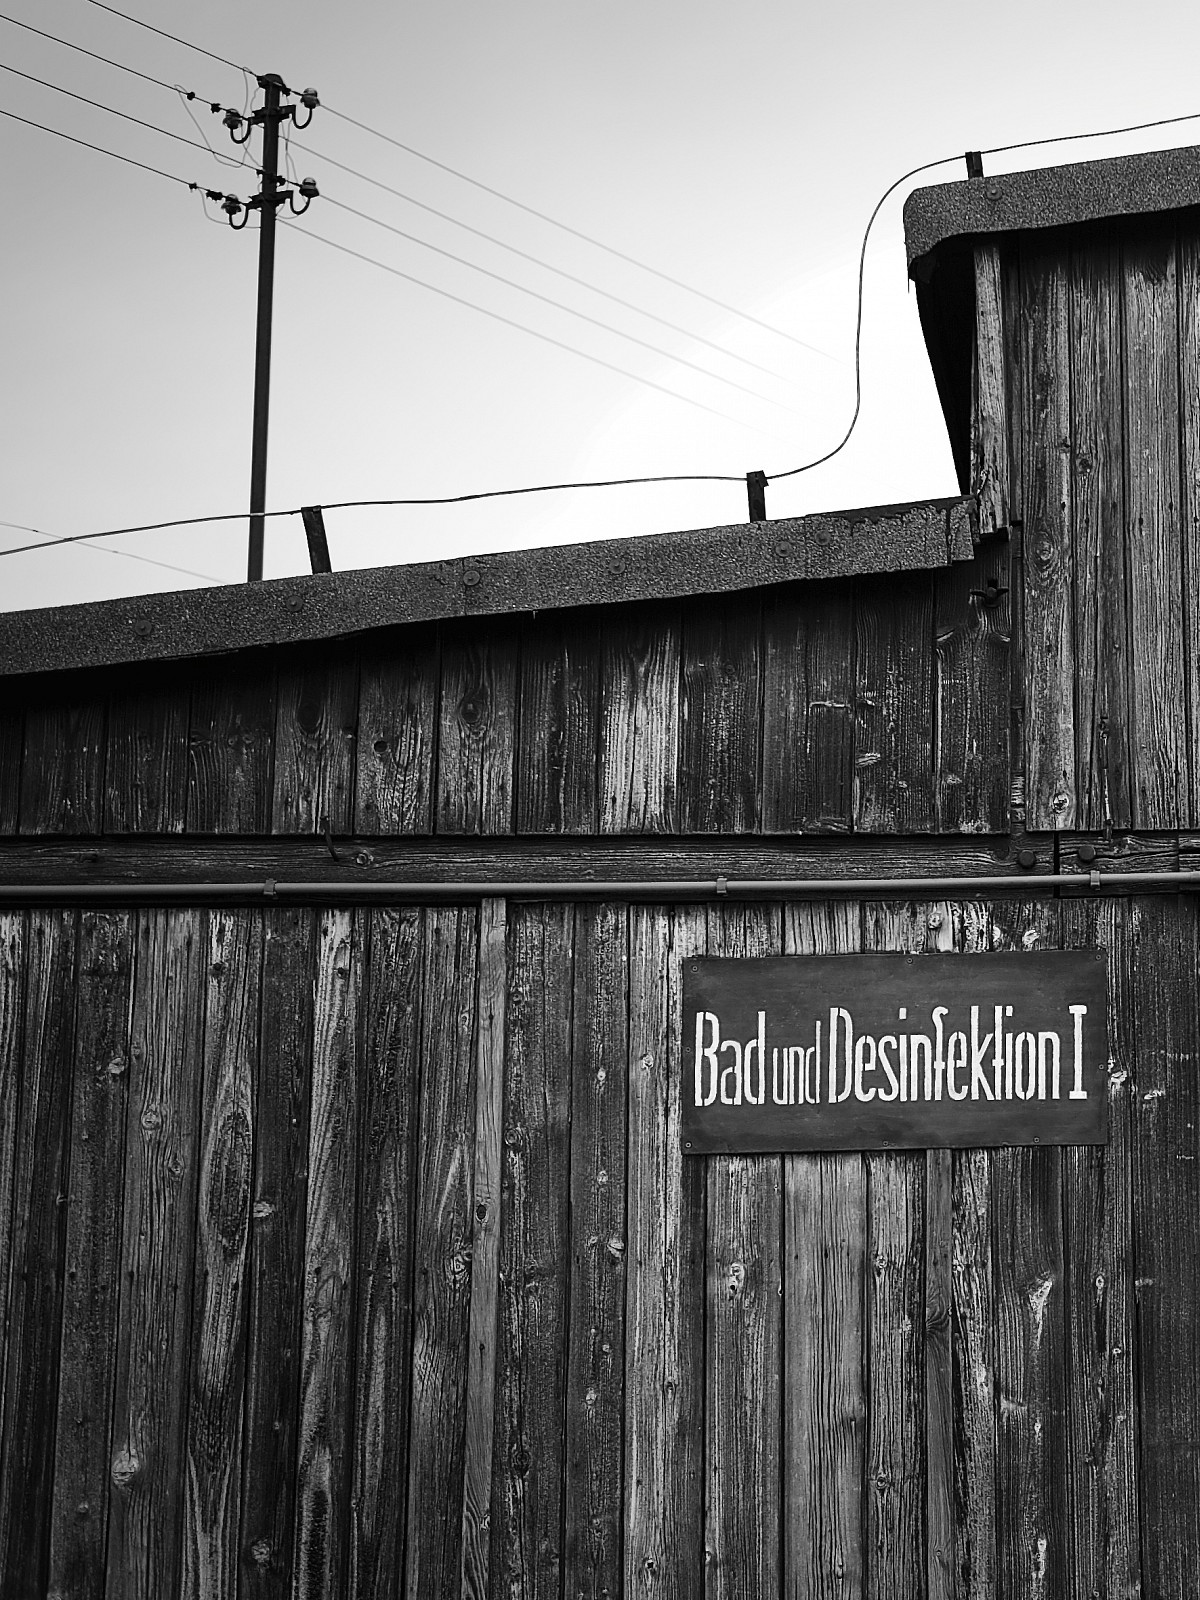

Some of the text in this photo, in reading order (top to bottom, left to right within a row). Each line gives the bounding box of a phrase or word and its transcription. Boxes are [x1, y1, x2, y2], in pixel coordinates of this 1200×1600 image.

[694, 1004, 1088, 1107] Bad und Desinfektion I
